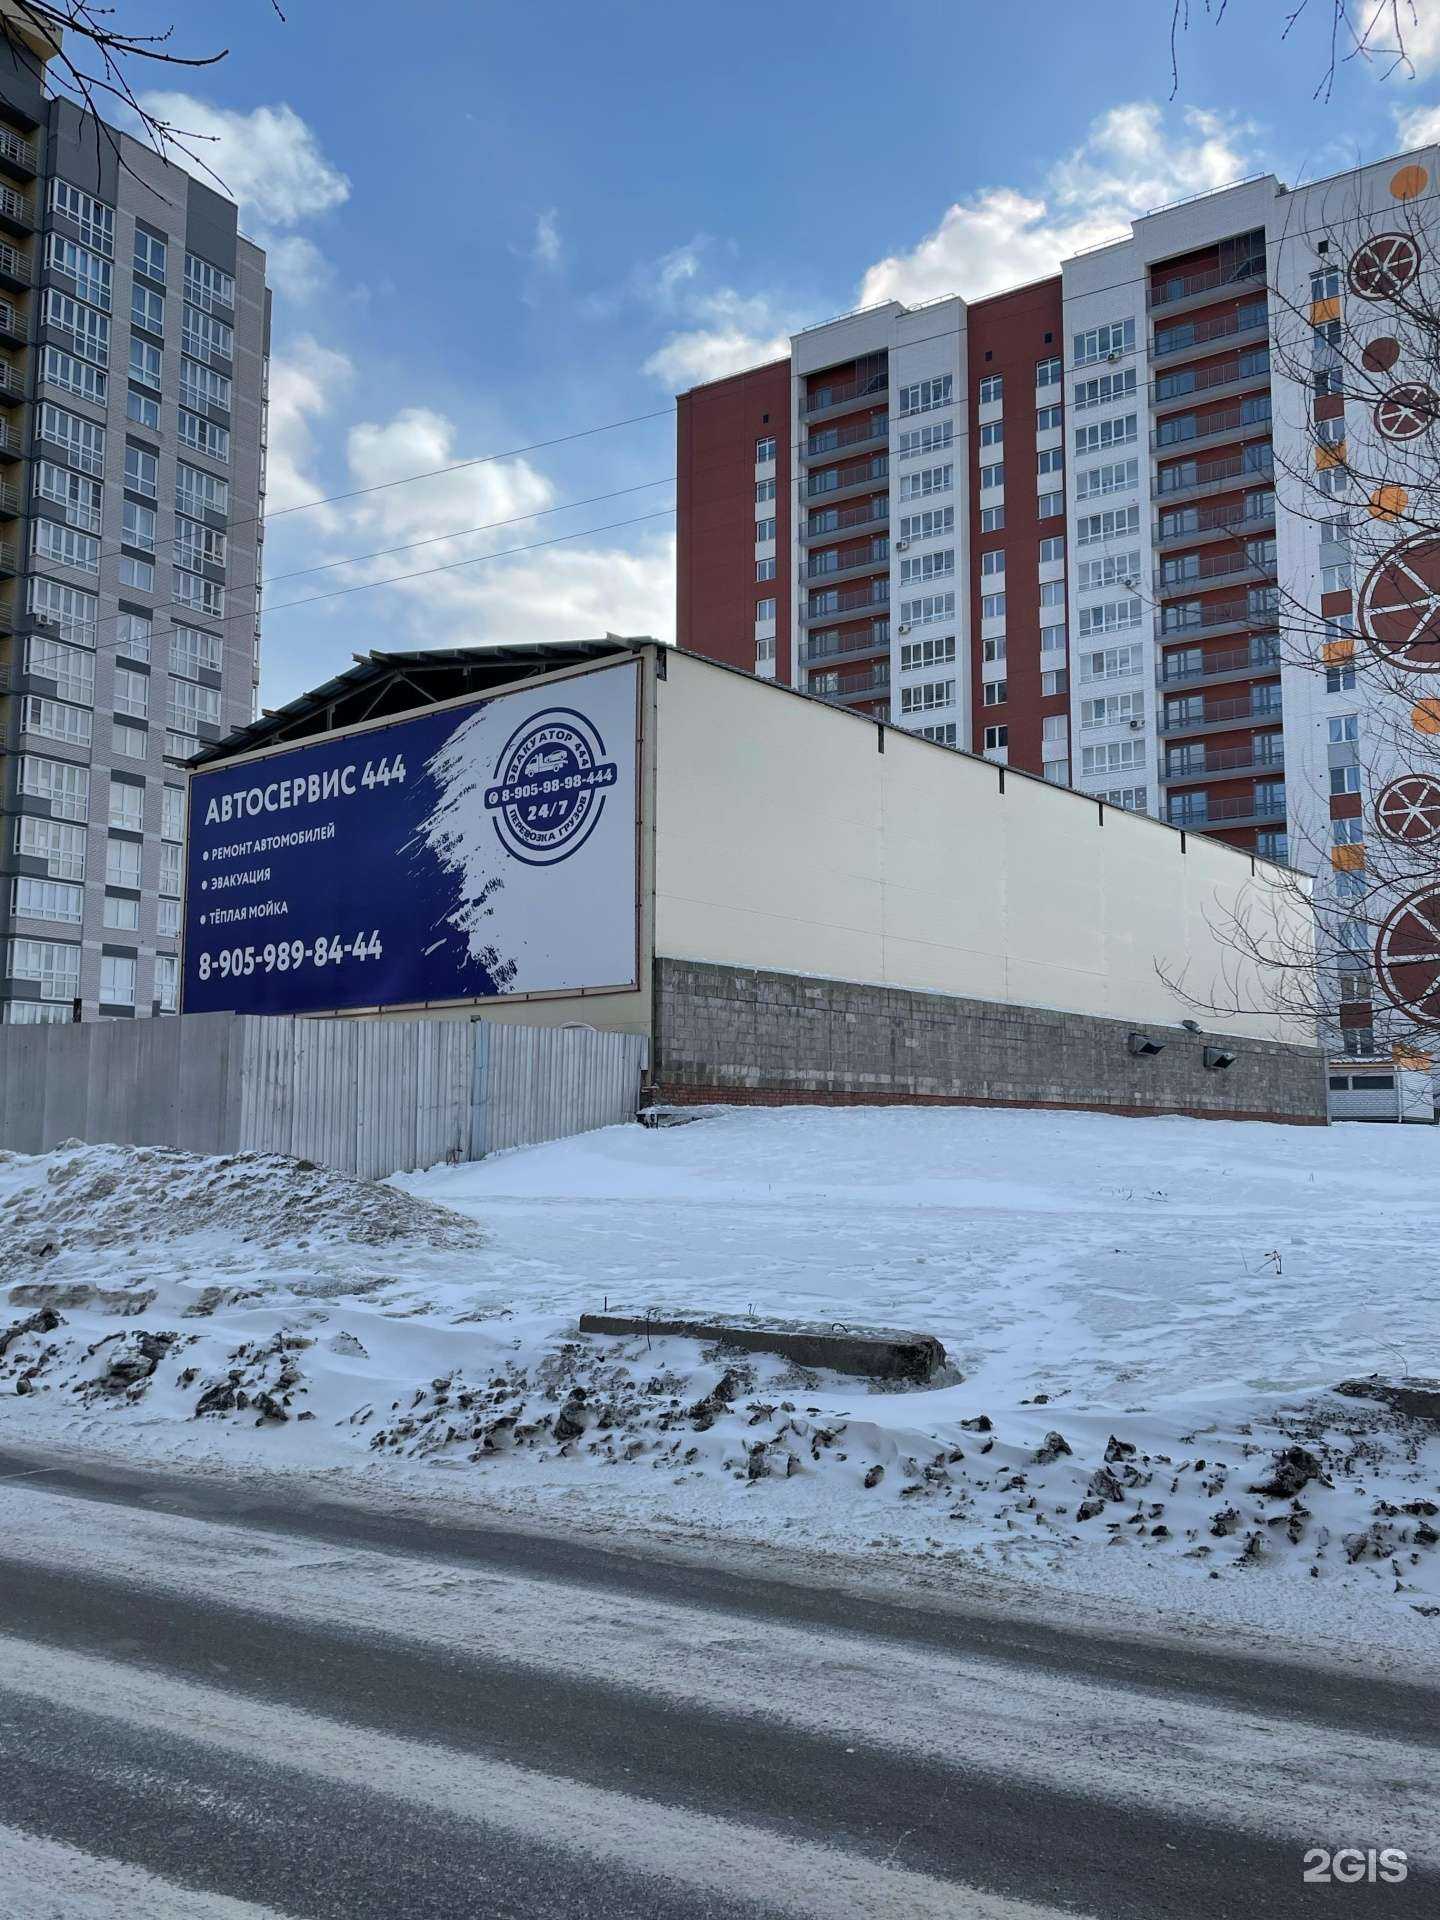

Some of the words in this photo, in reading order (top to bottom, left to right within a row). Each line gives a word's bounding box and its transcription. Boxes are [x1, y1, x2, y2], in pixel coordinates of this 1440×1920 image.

[508, 730, 573, 783] ЭВАКУАТОР
[574, 743, 590, 767] 444
[204, 765, 357, 826] АВТОСЕРВИС
[360, 753, 406, 791] 444
[502, 768, 613, 802] 8-905-98-98-444
[509, 808, 556, 843] ПЕРЕВОЗКА
[558, 796, 587, 837] ГРУЗОВ
[527, 800, 568, 821] 24/7
[211, 841, 252, 861] РЕМОНТ
[254, 821, 336, 854] АВТОМОБИЛЕЙ
[210, 868, 271, 890] ЭВАКУАЦИЯ
[209, 907, 247, 925] ТЁПЛАЯ
[248, 899, 288, 919] МОЙКА
[198, 929, 383, 981] 8-905-989-84-44
